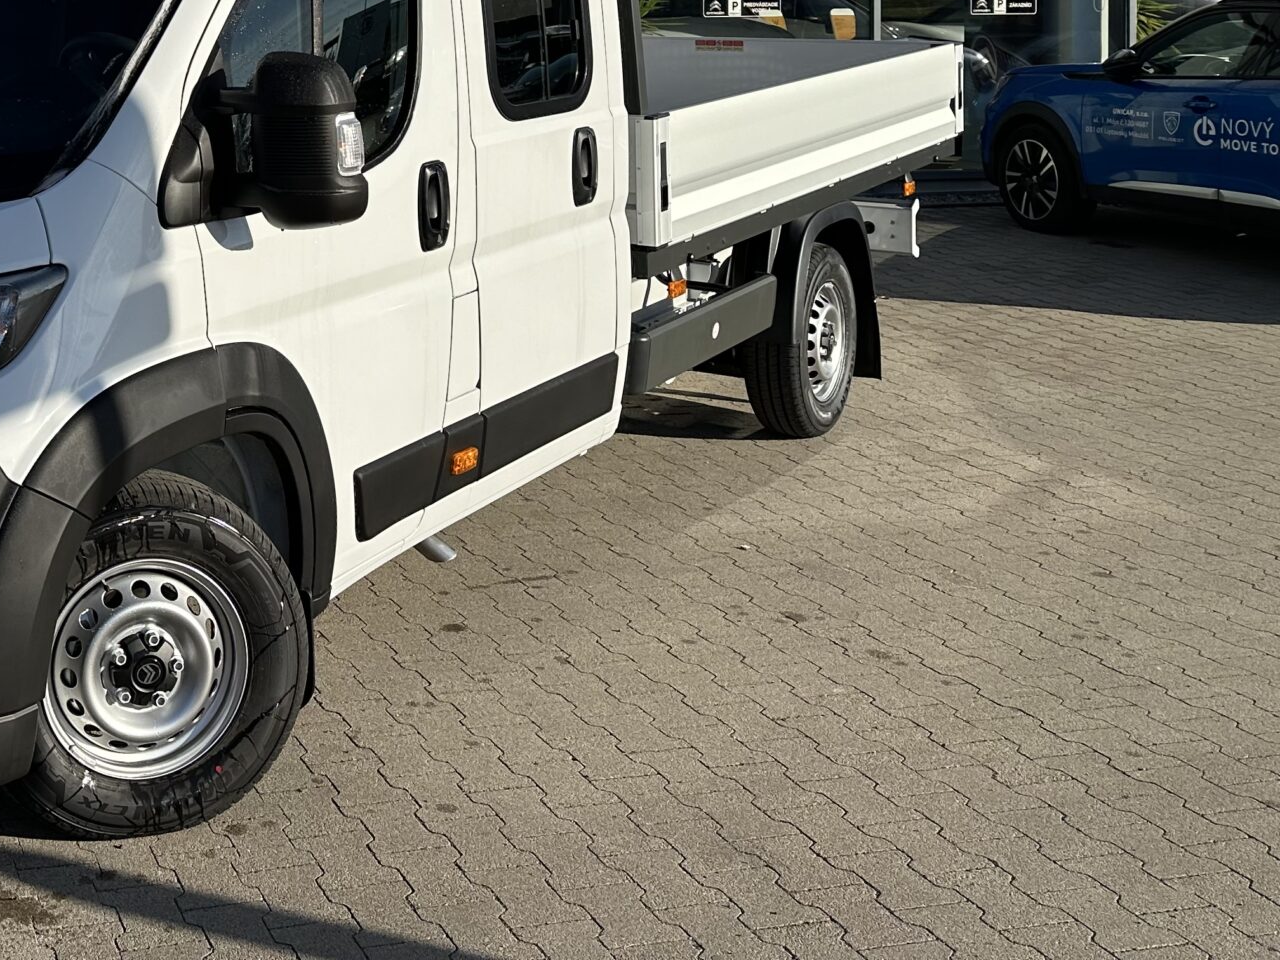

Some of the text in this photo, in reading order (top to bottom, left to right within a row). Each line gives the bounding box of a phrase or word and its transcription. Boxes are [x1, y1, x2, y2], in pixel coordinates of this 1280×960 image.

[732, 1, 738, 11] P
[997, 0, 1004, 8] P
[1221, 117, 1275, 139] NOVÝ
[1221, 138, 1280, 156] MOVE TO
